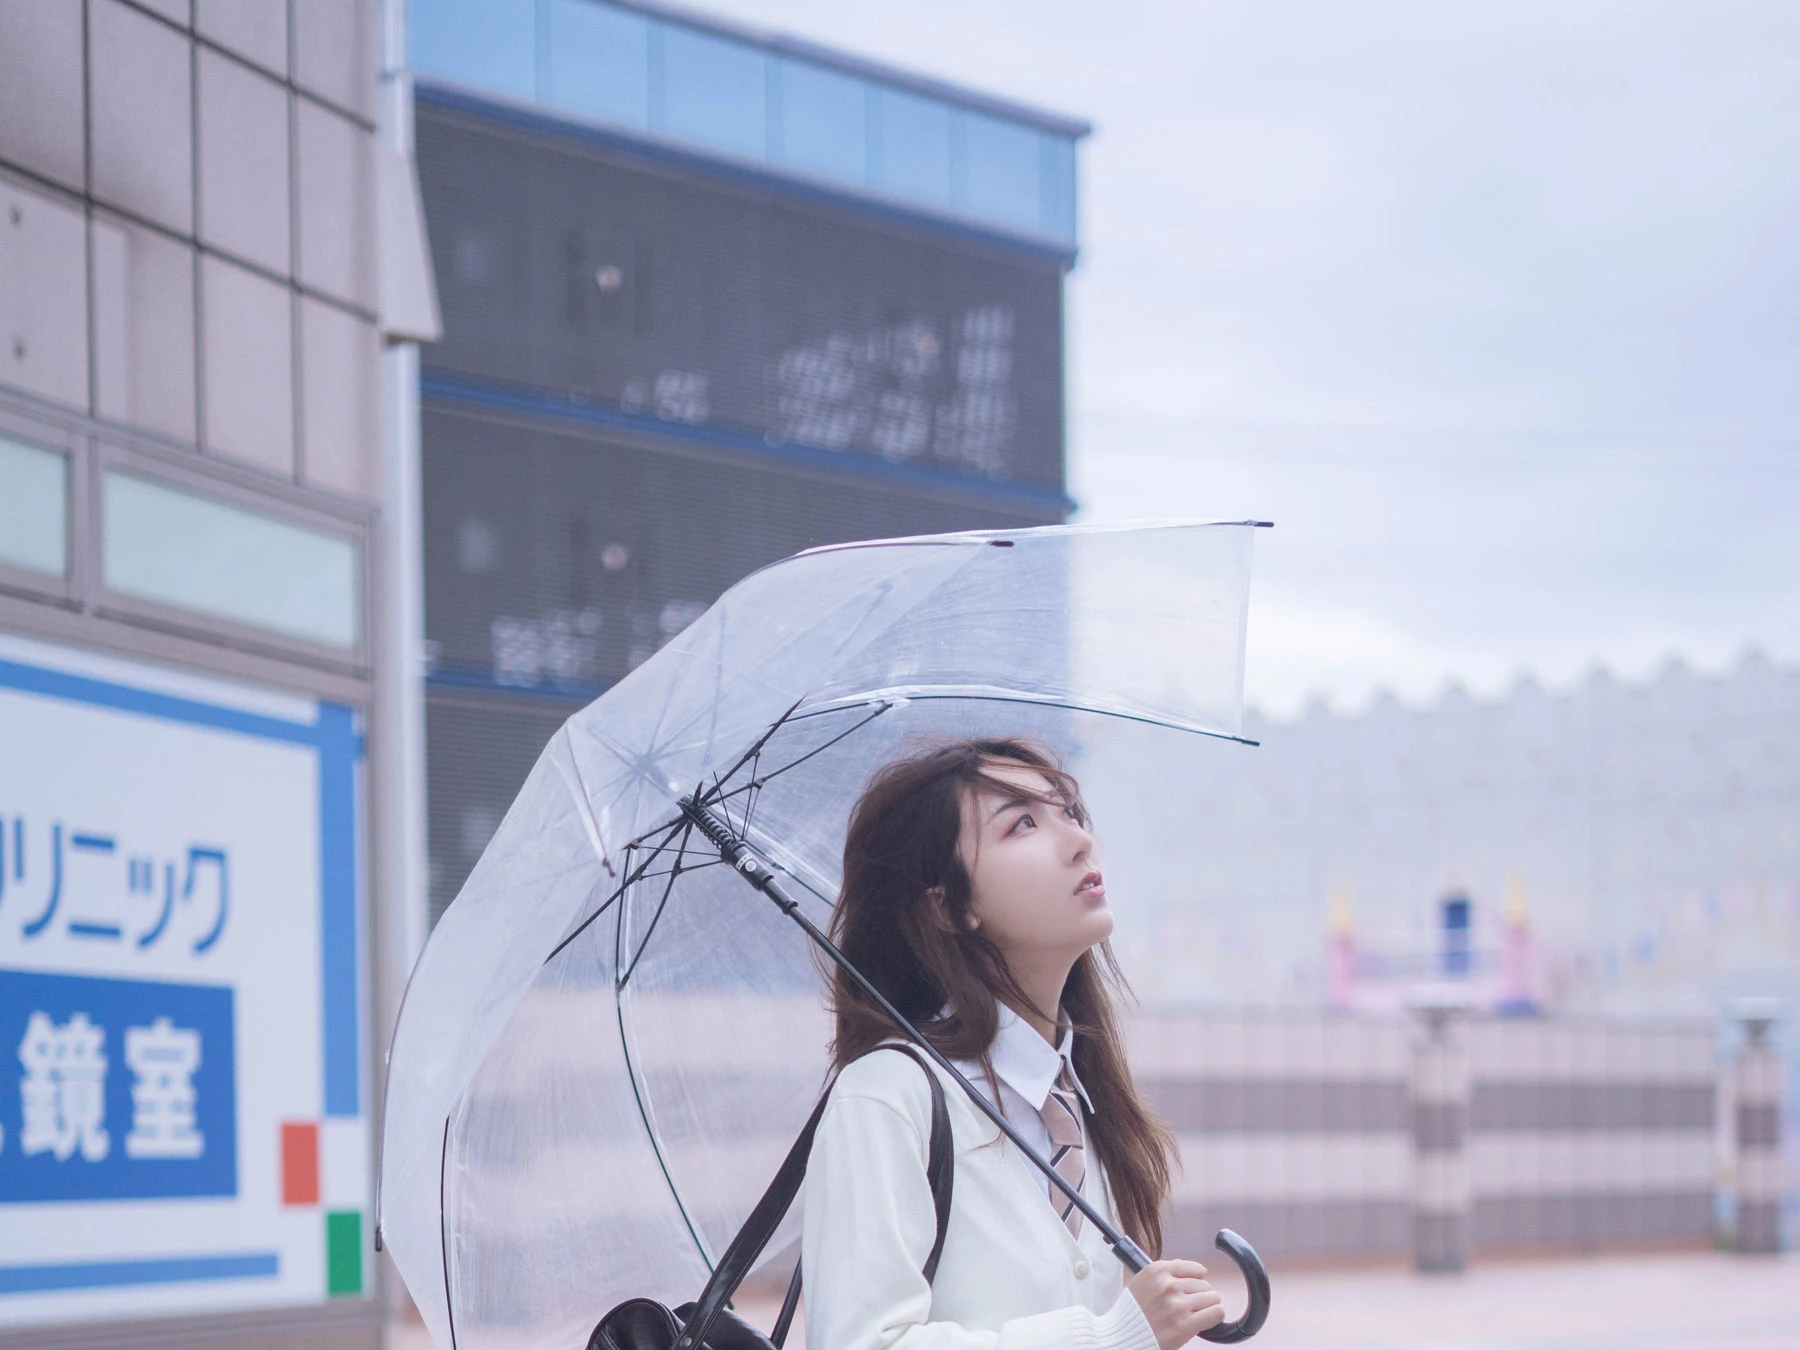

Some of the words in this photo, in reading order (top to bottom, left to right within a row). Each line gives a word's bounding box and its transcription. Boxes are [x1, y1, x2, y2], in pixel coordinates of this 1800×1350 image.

[0, 816, 228, 956] リニック
[0, 1010, 204, 1162] 鏡室
